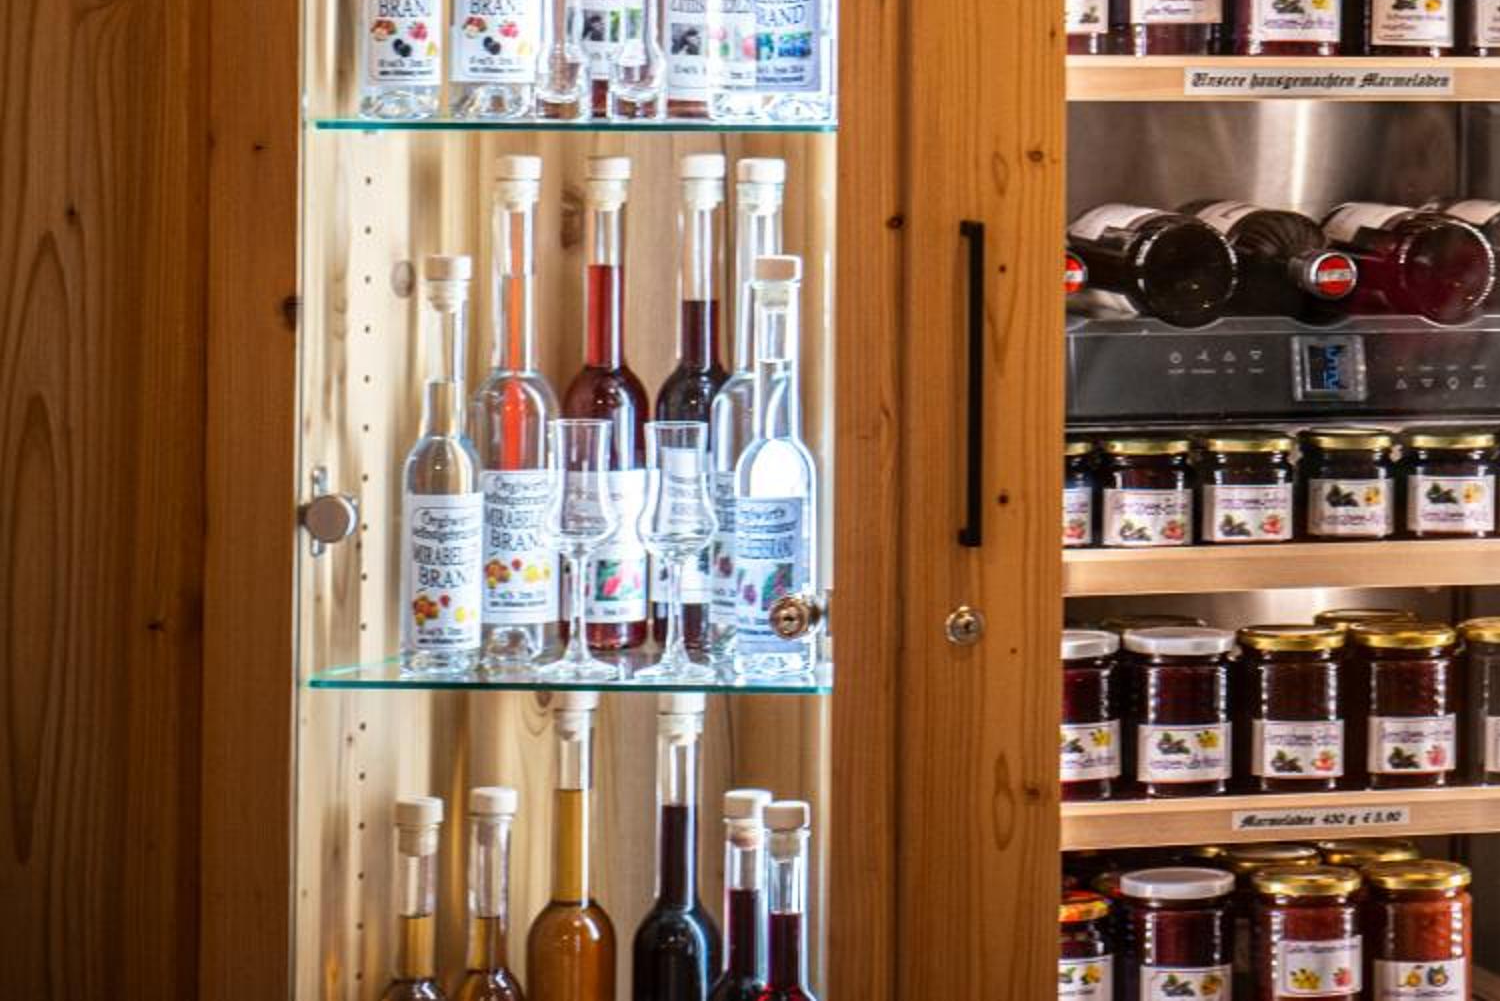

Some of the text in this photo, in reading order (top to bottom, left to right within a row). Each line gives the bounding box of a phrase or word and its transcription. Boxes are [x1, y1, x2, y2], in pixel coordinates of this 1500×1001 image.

[1192, 72, 1450, 90] Unsere hausgemachten Marmeladen
[490, 529, 541, 550] BRAN
[418, 566, 468, 589] BRAN
